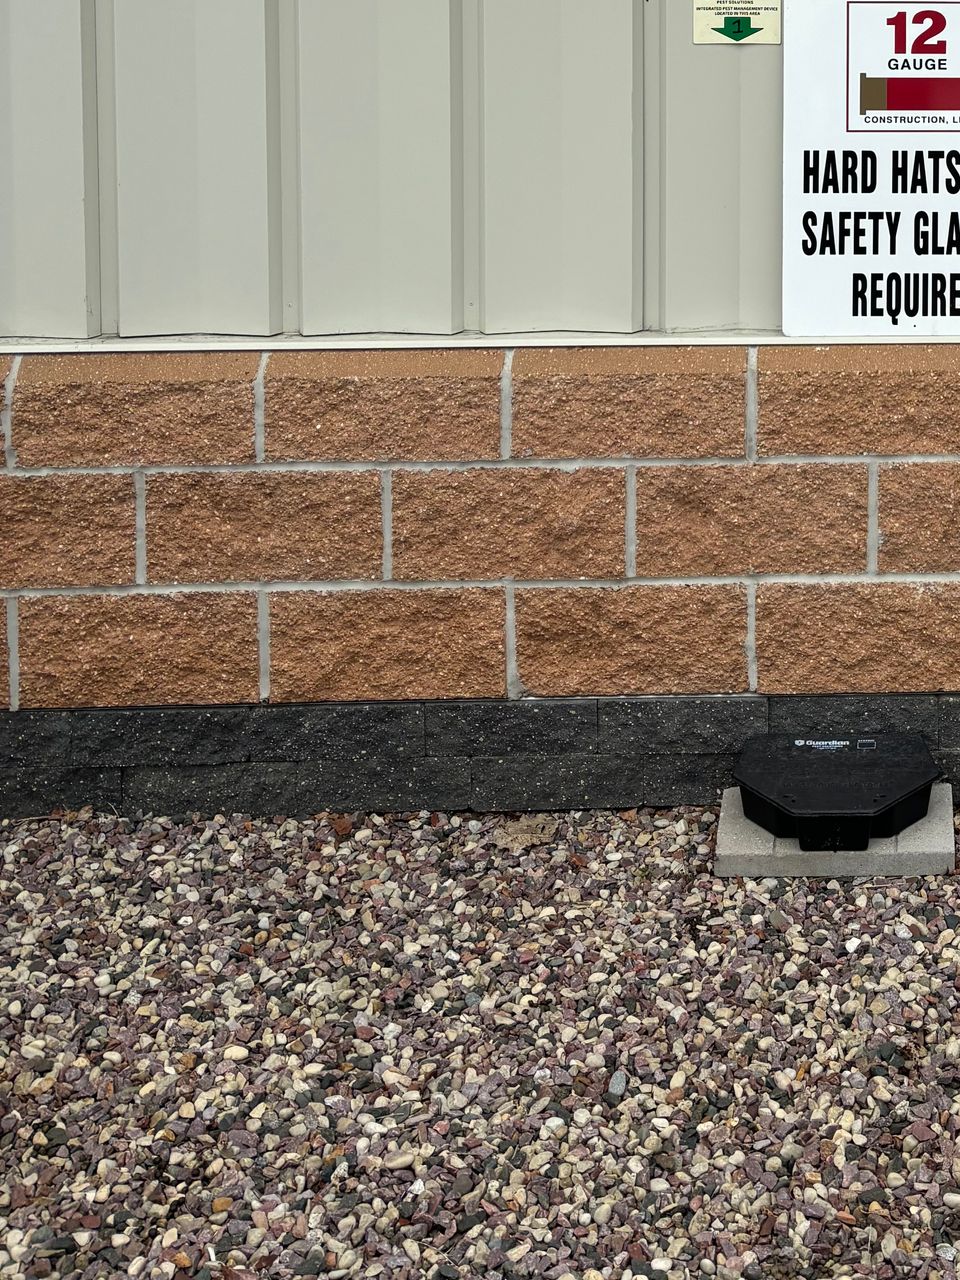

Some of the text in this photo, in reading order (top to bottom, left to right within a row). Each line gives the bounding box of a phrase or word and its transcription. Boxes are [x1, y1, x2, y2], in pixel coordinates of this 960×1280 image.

[732, 18, 744, 34] 1
[886, 9, 948, 55] 12
[887, 58, 948, 71] GAUGE
[863, 116, 949, 125] CONSTRUCTION,
[803, 150, 878, 194] HARD
[801, 211, 902, 256] SAFETY
